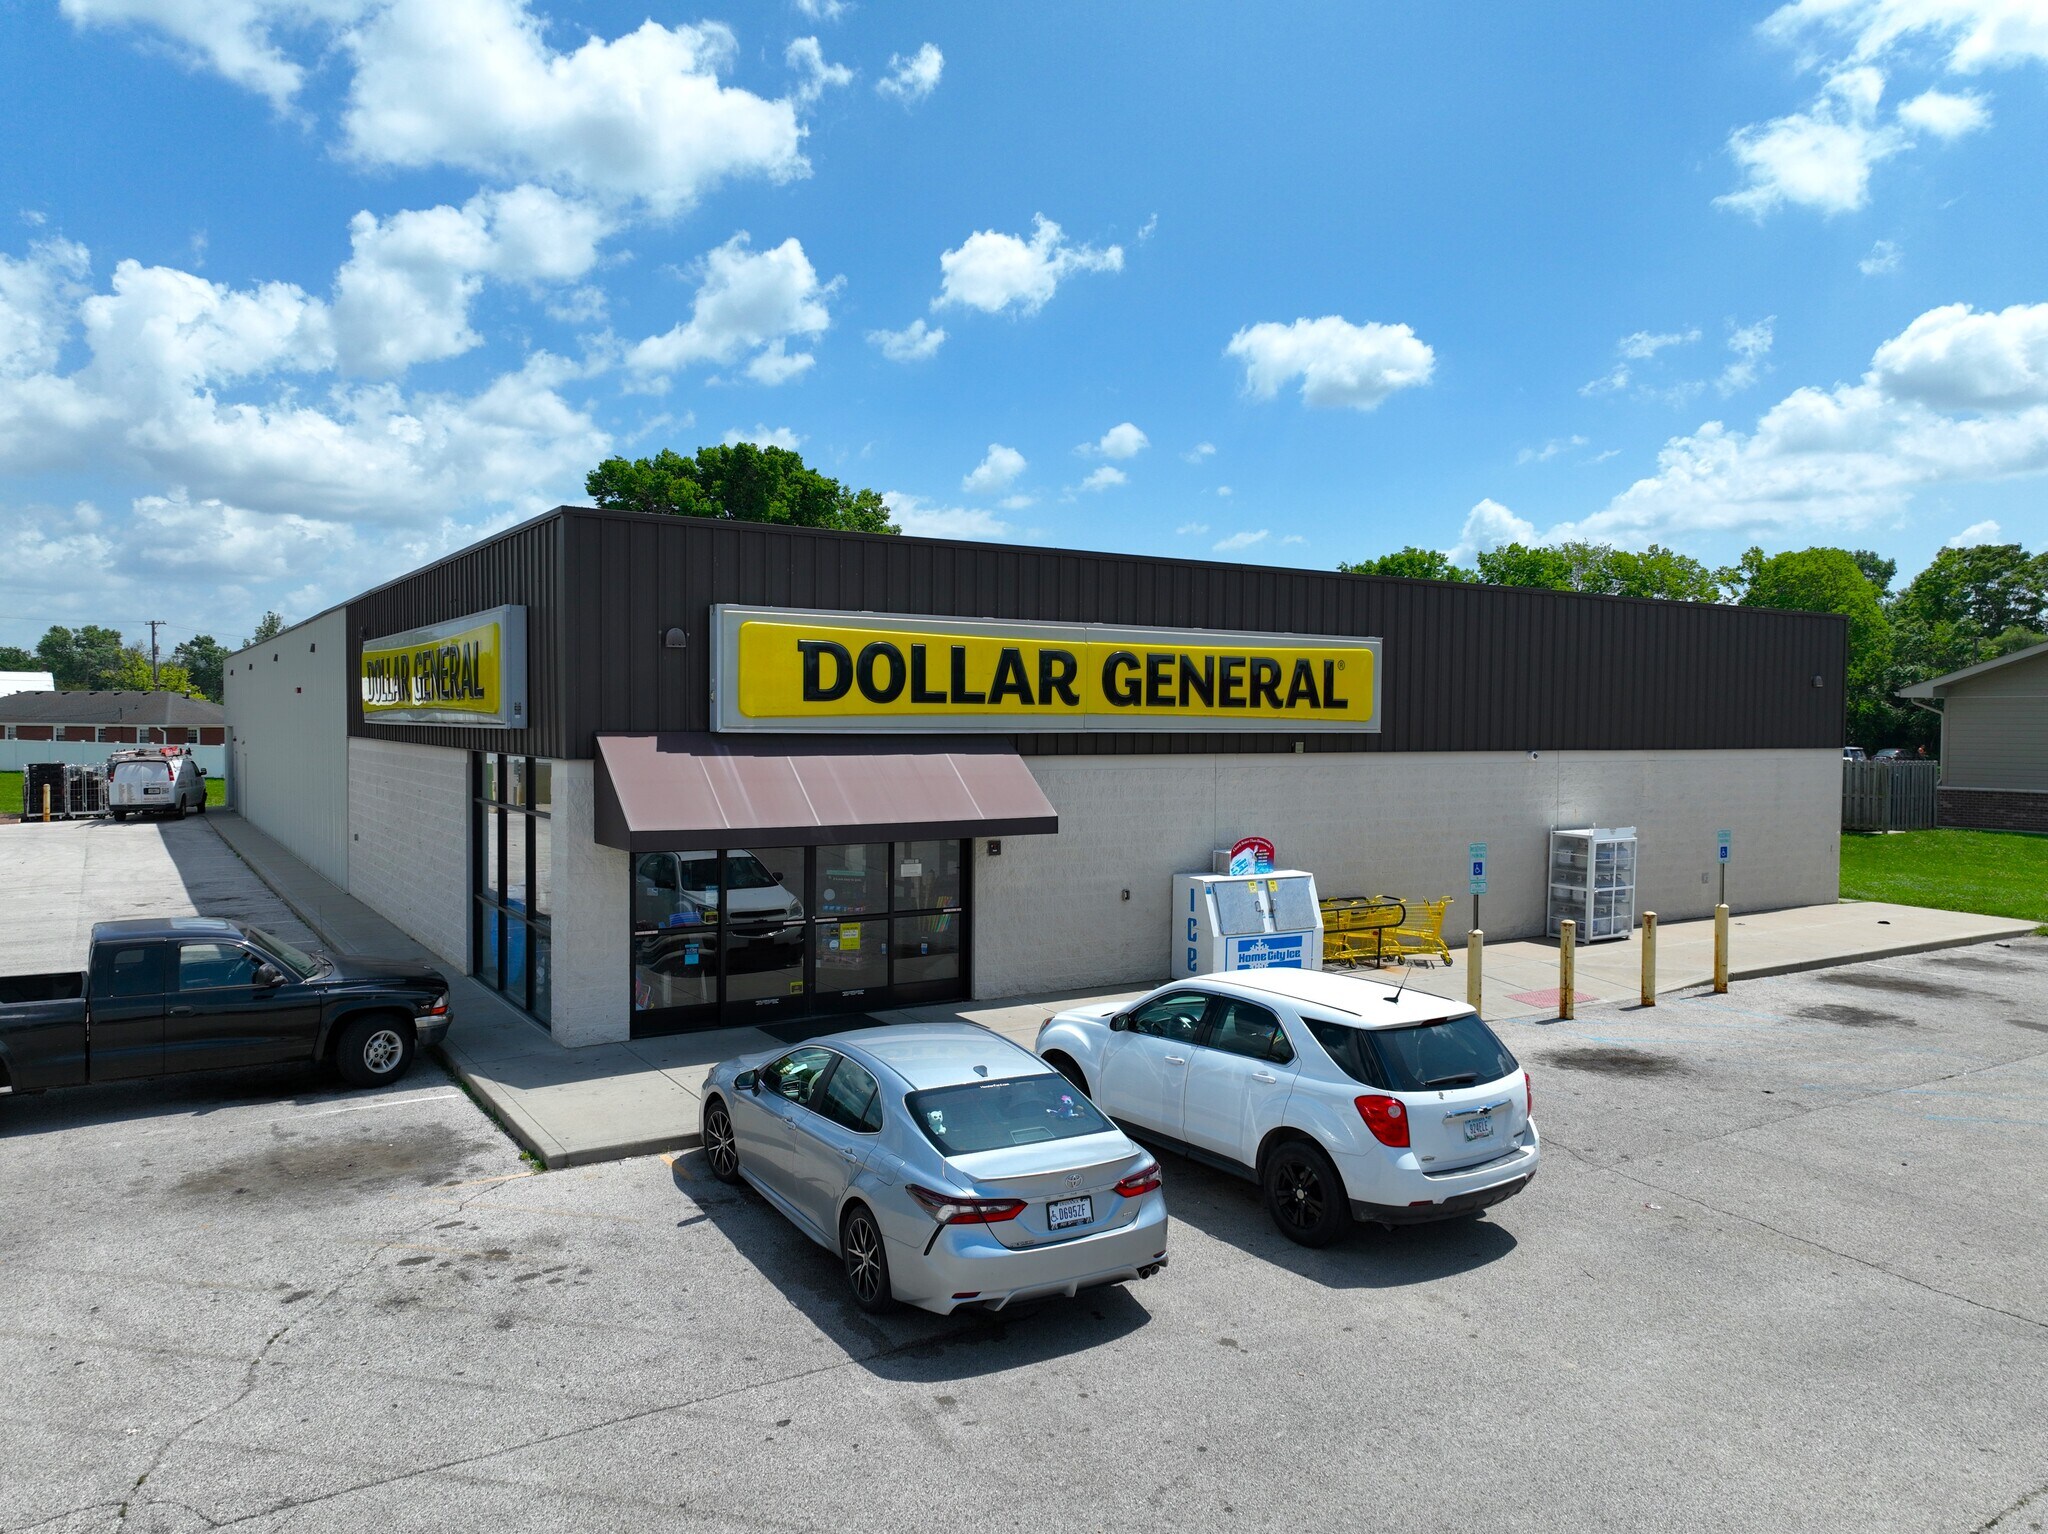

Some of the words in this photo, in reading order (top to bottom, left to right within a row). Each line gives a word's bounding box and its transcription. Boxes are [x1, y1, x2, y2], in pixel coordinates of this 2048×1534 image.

[366, 653, 411, 702] DOLLAR
[414, 640, 484, 702] GENERAL
[797, 639, 1080, 705] DOLLAR
[1238, 953, 1267, 963] Home
[1267, 950, 1286, 962] City
[1286, 949, 1301, 959] Ice
